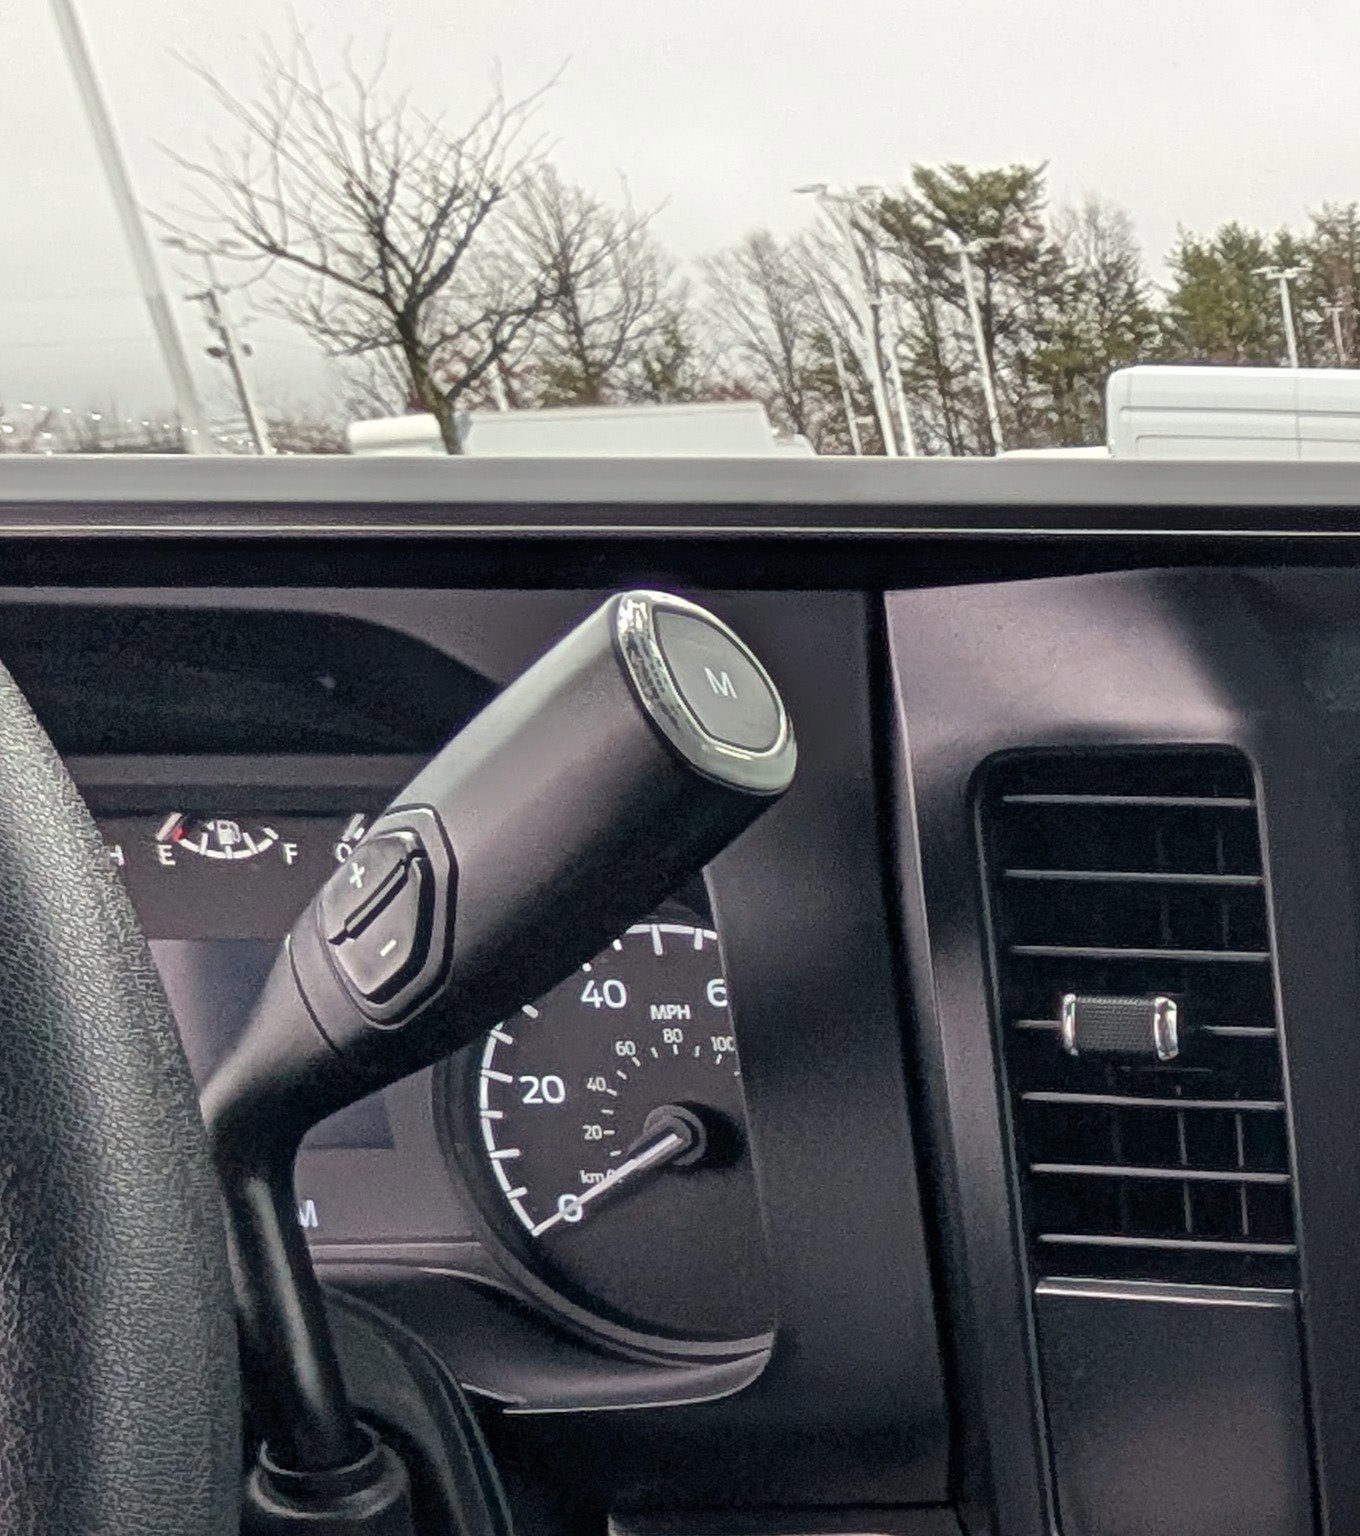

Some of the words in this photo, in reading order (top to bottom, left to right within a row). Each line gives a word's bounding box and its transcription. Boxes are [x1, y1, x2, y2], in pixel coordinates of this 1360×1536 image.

[703, 666, 738, 699] M
[158, 844, 176, 866] E
[282, 843, 298, 865] F
[580, 979, 627, 1009] 40
[706, 978, 729, 1008] 6
[650, 1004, 691, 1021] MPH
[663, 1028, 683, 1044] 80
[615, 1040, 636, 1057] 60
[519, 1075, 565, 1104] 20
[586, 1076, 607, 1092] 40
[582, 1125, 602, 1140] 20
